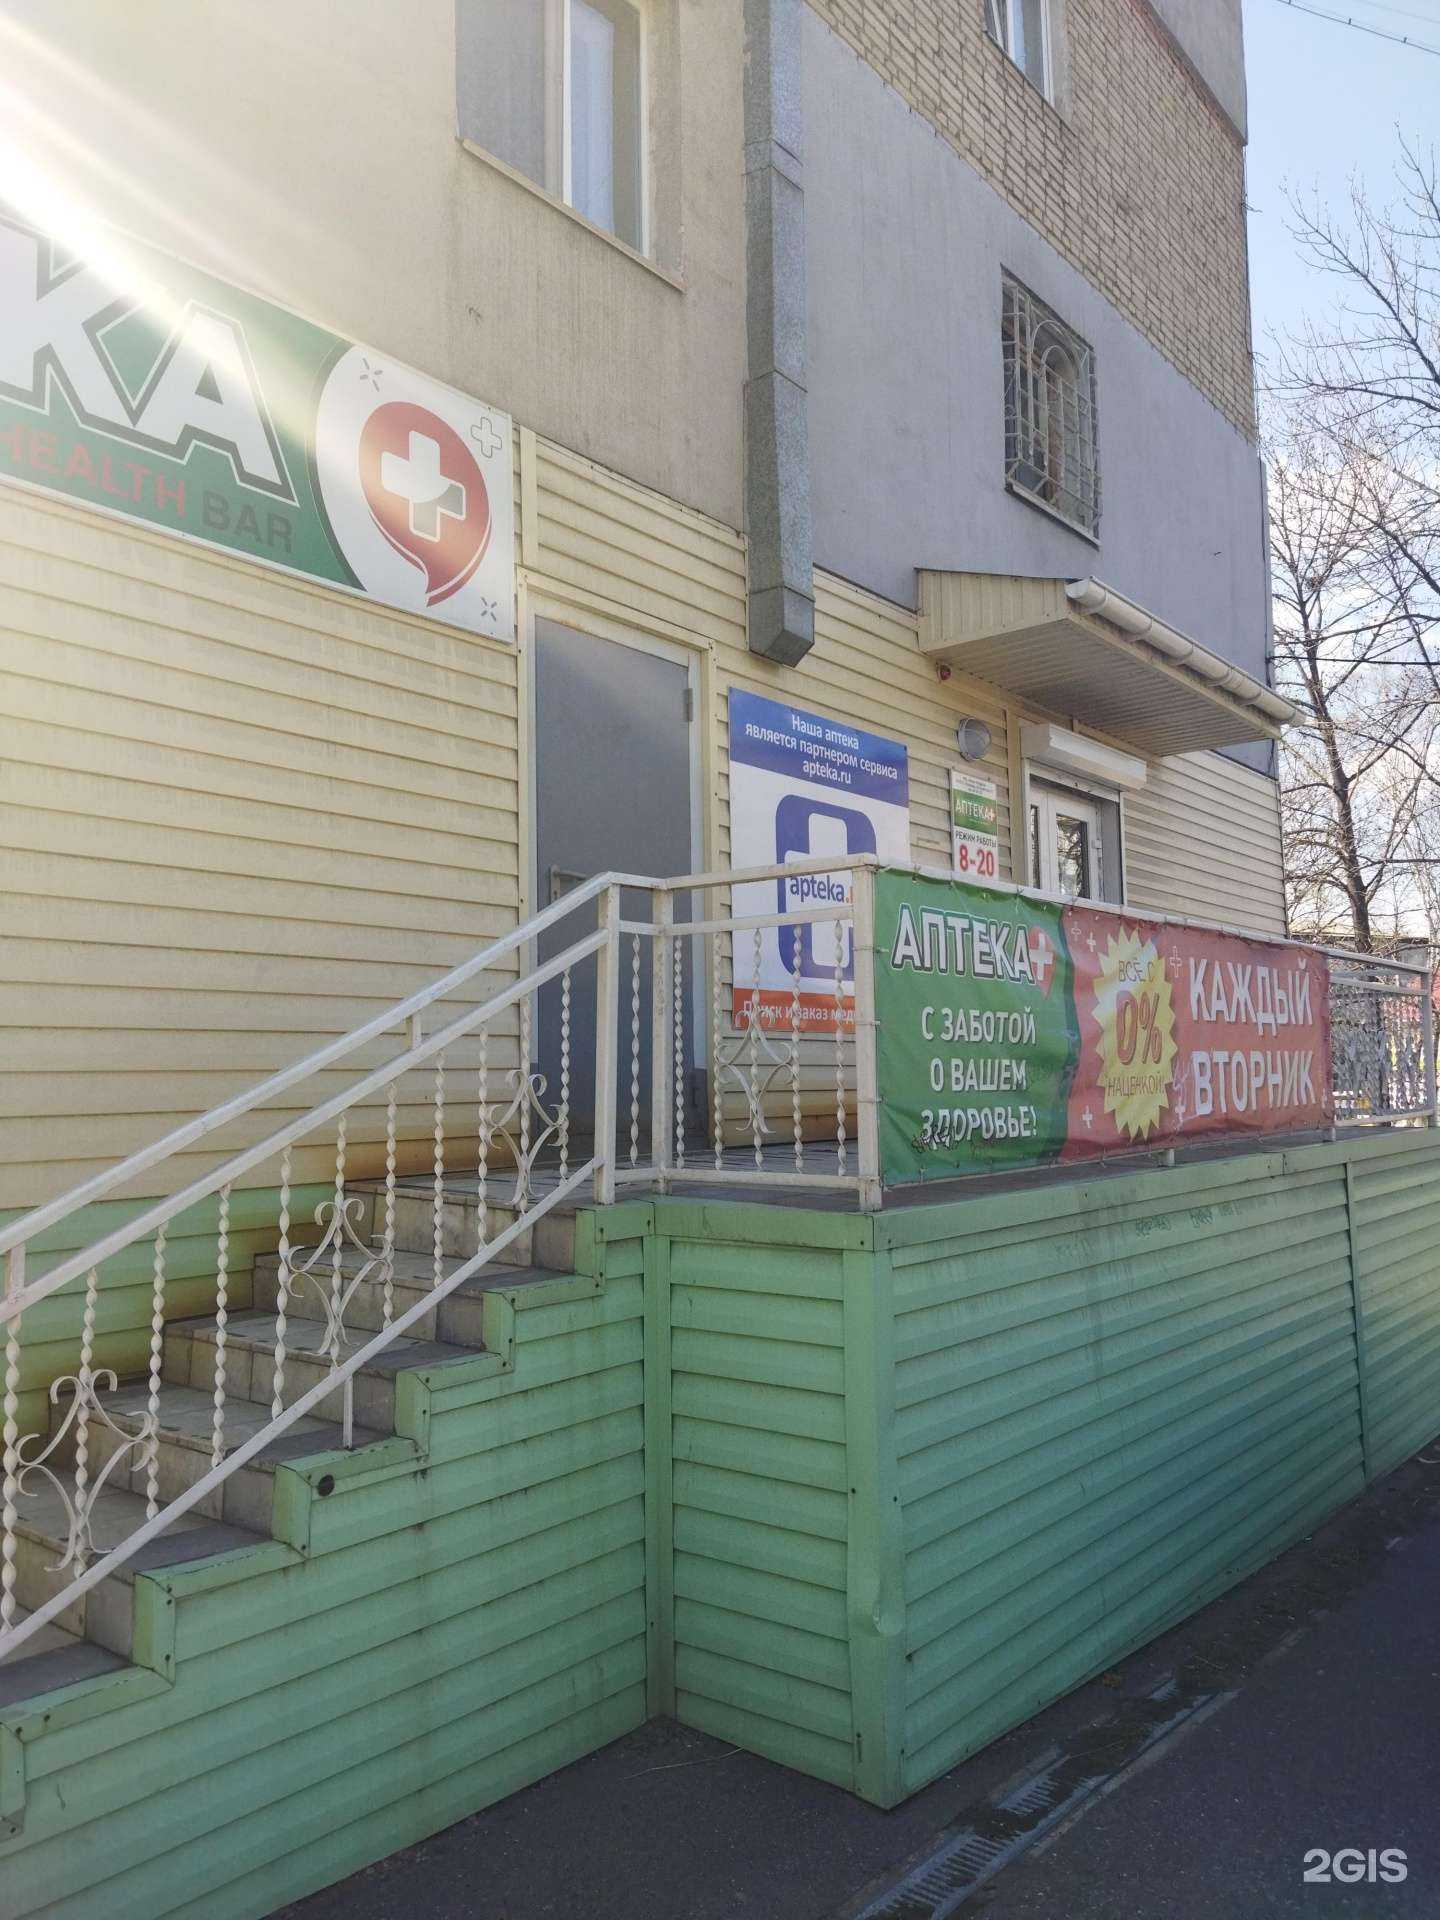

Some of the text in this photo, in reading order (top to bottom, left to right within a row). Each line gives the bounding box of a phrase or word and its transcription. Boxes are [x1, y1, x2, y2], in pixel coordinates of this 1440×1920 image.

[202, 490, 293, 553] BAR
[745, 723, 898, 780] является партнером сервиса
[791, 714, 859, 749] Наша аптека
[802, 761, 851, 784] apteka.ru
[960, 844, 994, 877] 8-20
[1188, 957, 1313, 1037] КАЖДЫЙ
[922, 1006, 1037, 1045] С ЗАБОТОЙ
[1115, 990, 1163, 1066] 0%
[930, 1058, 1027, 1091] О ВАШЕМ
[1190, 1050, 1317, 1116] ВТОРНИК
[920, 1105, 1038, 1150] ЗДОРОВЬЕ!
